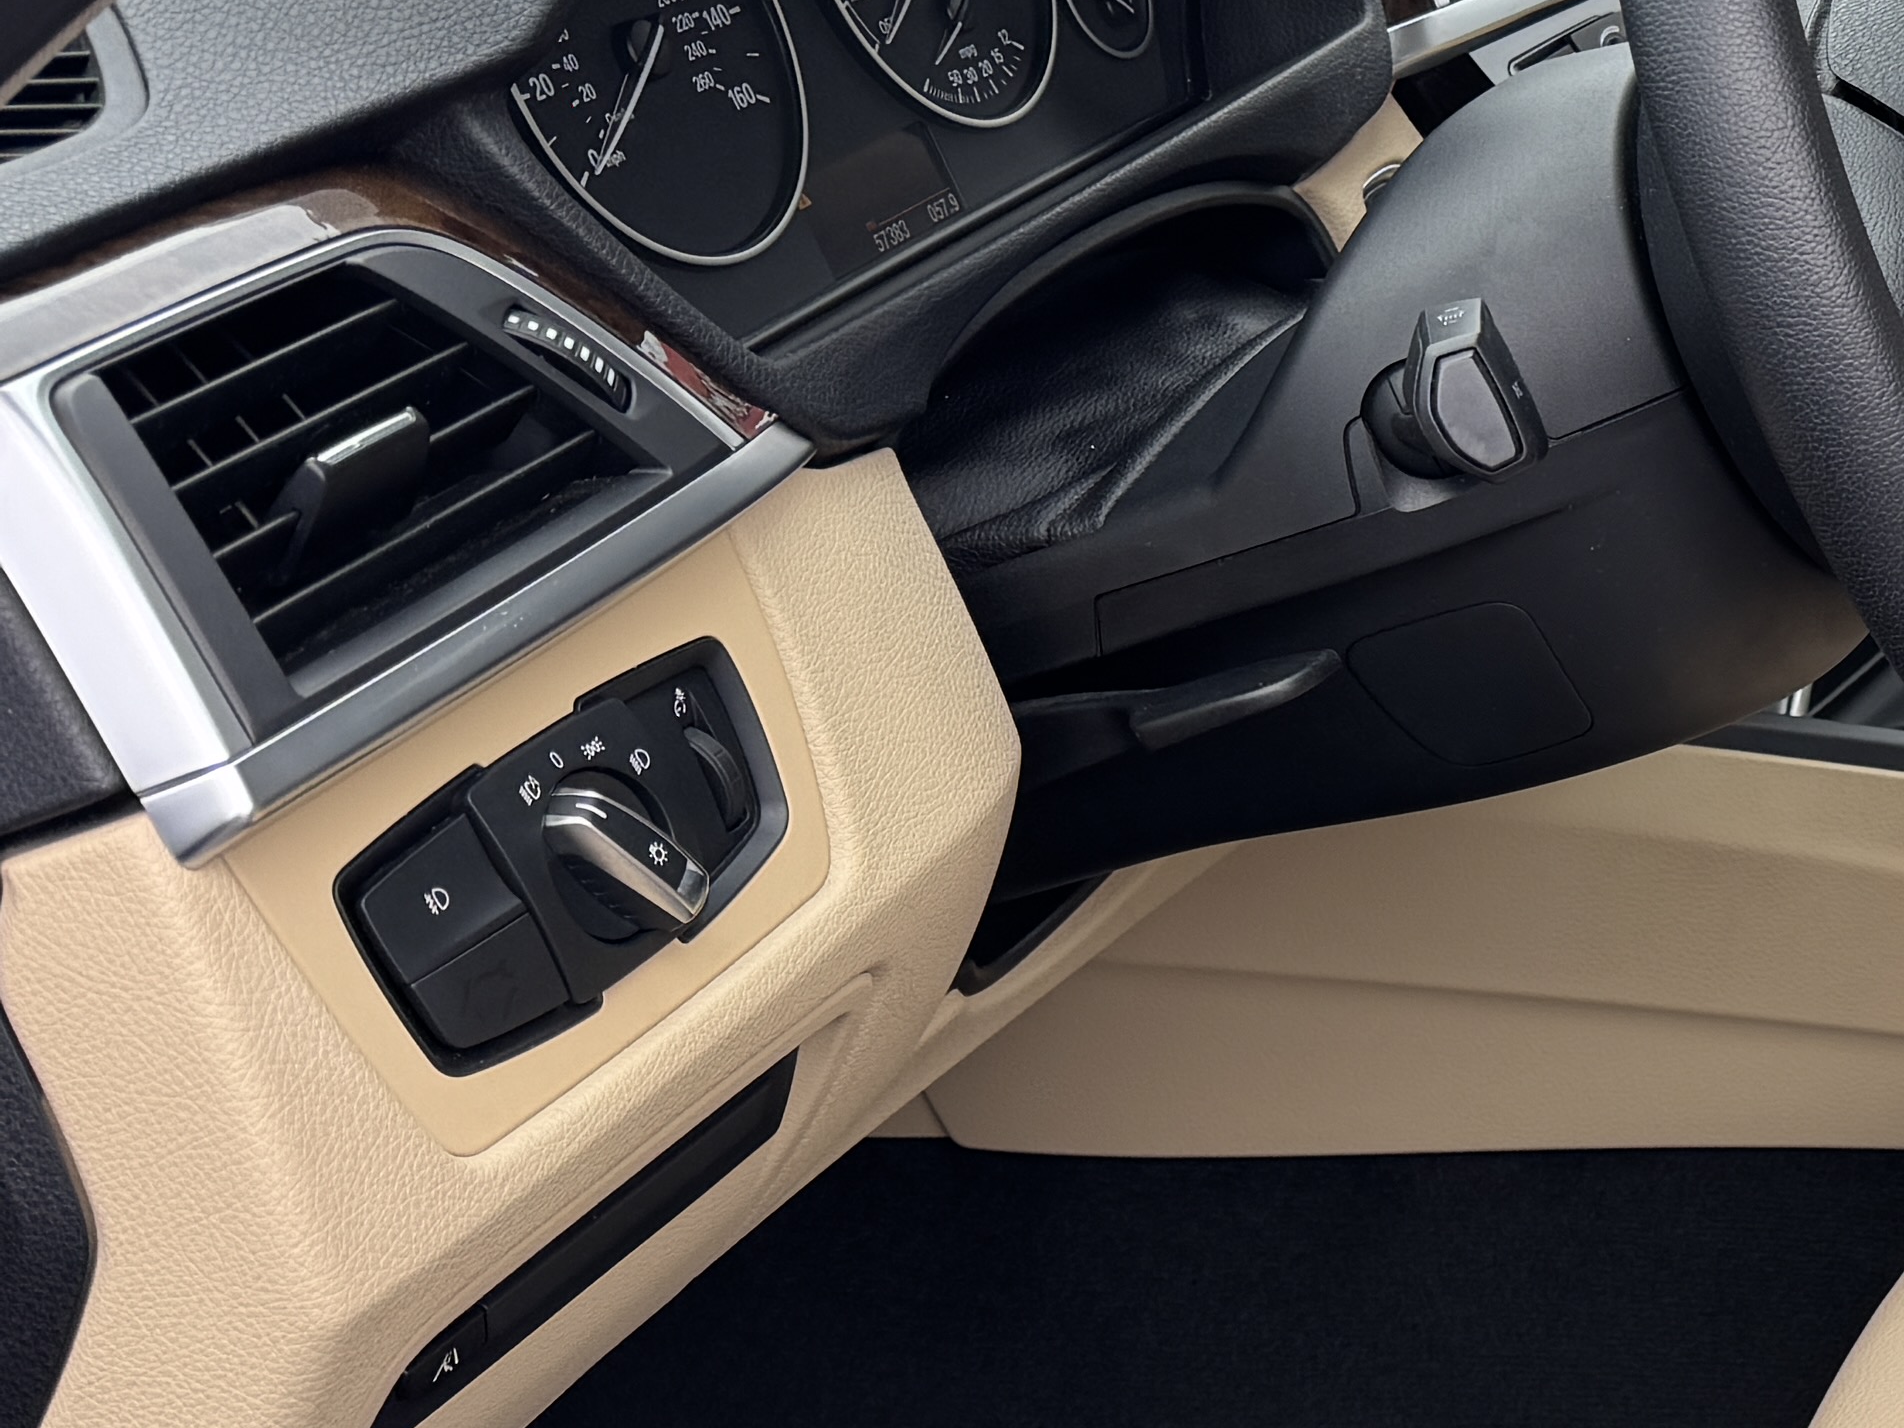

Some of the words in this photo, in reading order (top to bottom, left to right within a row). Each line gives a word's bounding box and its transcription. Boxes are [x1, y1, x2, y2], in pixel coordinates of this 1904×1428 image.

[672, 12, 694, 33] 220
[702, 4, 731, 31] 140
[998, 29, 1012, 46] 12
[684, 40, 707, 62] 240
[990, 48, 1004, 64] 15
[562, 54, 579, 72] 40
[978, 59, 993, 78] 20
[692, 71, 715, 93] 260
[963, 67, 978, 85] 30
[529, 73, 555, 101] 20
[578, 83, 597, 102] 20
[728, 82, 757, 110] 160
[873, 220, 911, 252] 57383
[927, 193, 960, 223] 057.9
